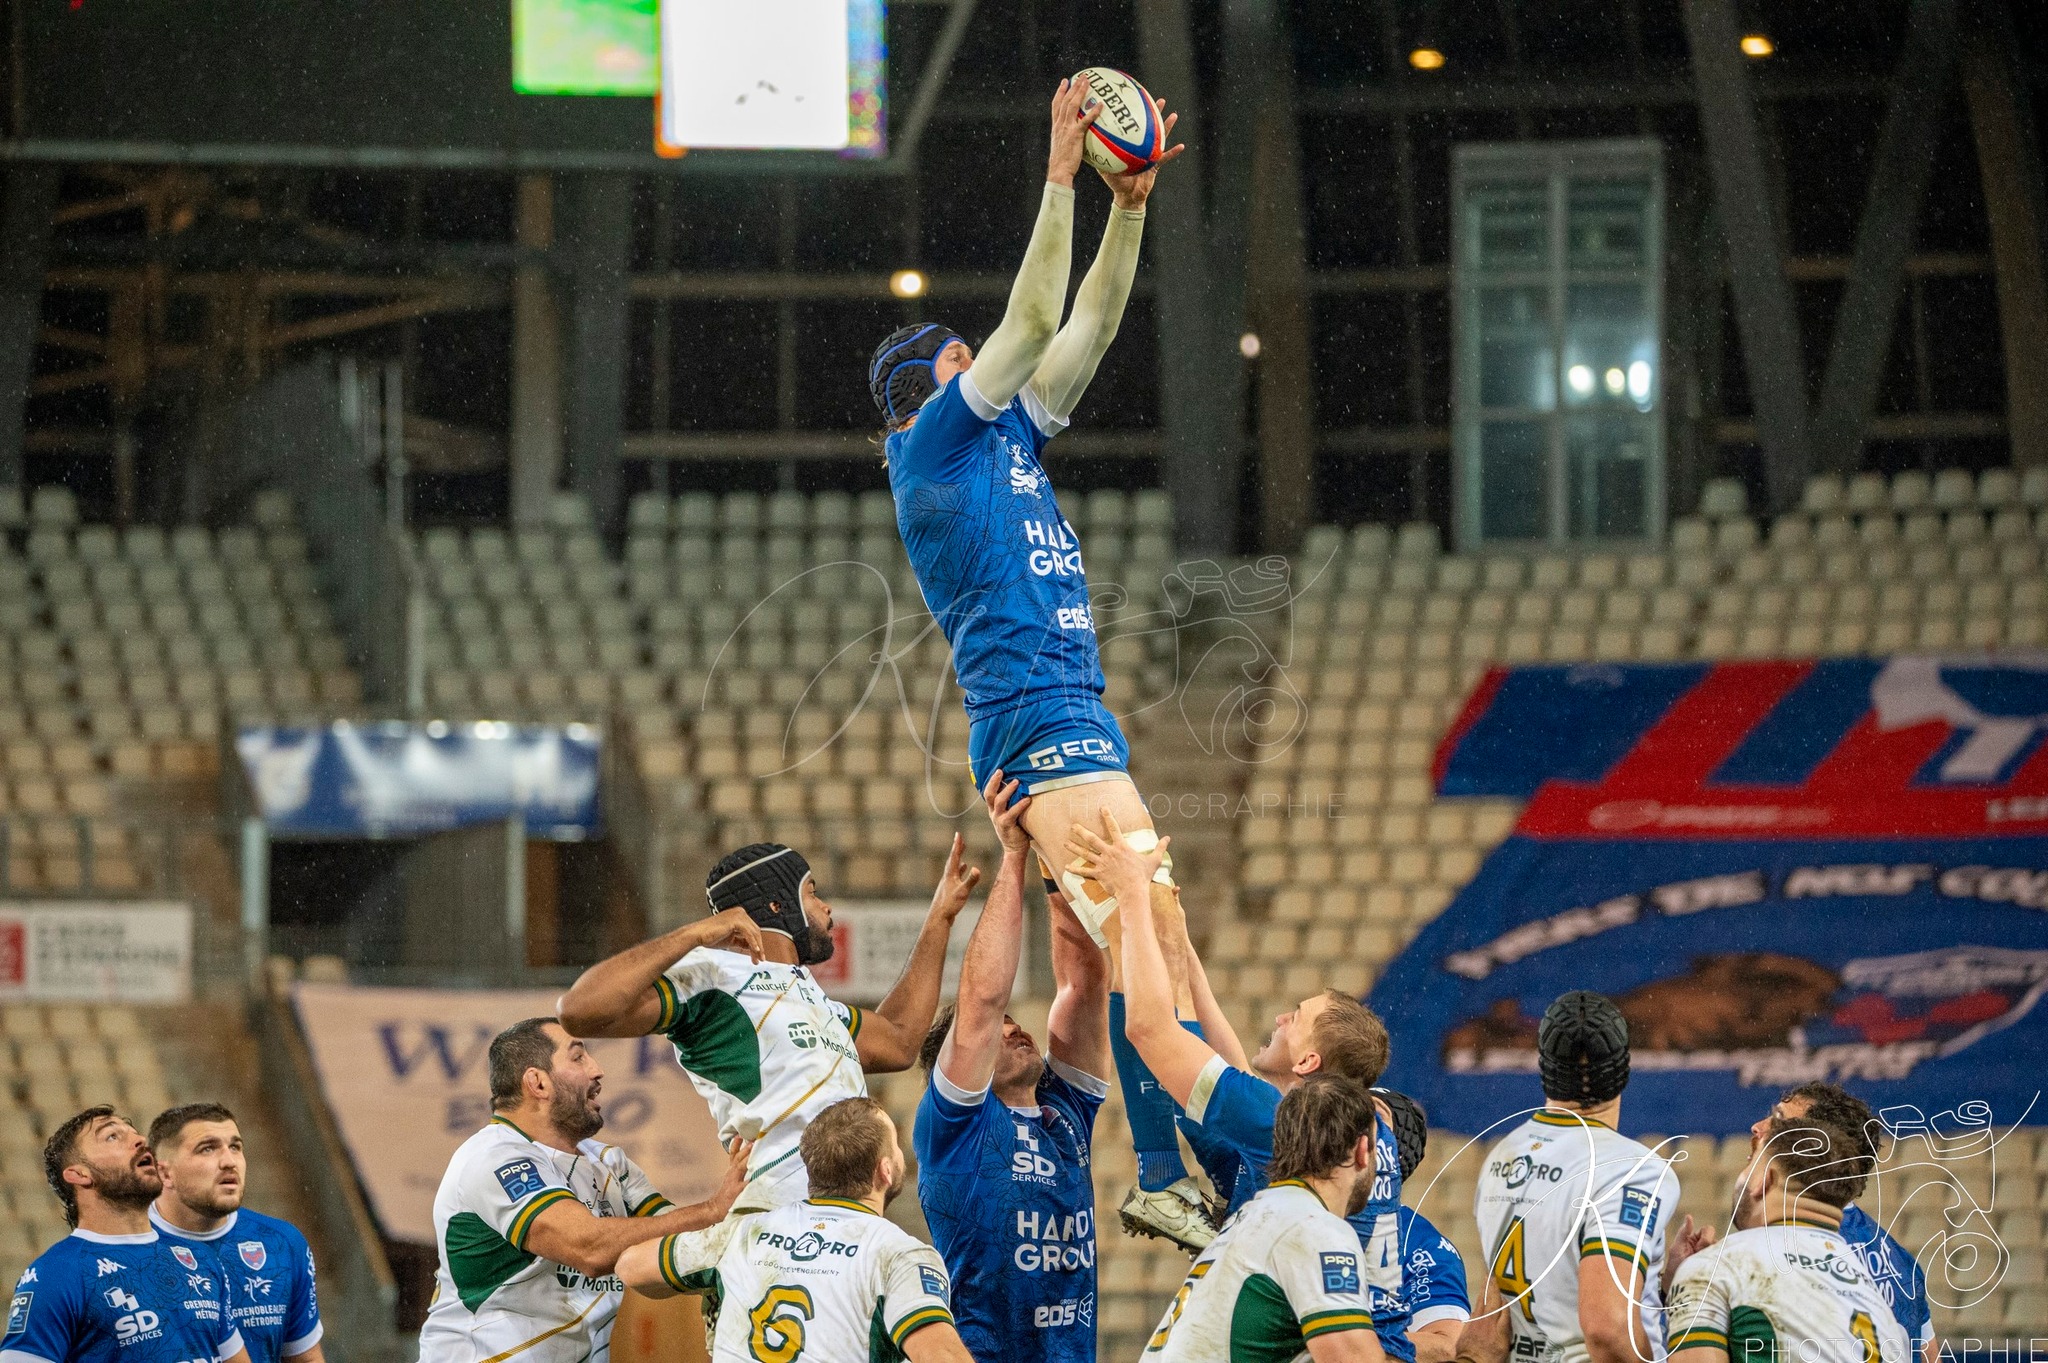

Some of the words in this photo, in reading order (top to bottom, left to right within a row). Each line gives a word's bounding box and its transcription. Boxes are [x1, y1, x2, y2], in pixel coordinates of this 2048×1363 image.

[1084, 149, 1113, 168] AICA
[1061, 738, 1117, 757] ECM
[749, 980, 789, 992] FAUCHÉ
[500, 1162, 531, 1179] PRO
[1012, 1151, 1056, 1177] SD
[509, 1177, 543, 1200] D2
[1012, 1172, 1056, 1187] SERVICES
[1324, 1256, 1355, 1266] PRO
[1494, 1215, 1539, 1325] 4
[581, 1276, 624, 1292] Monta
[1328, 1275, 1358, 1289] D2
[115, 1309, 160, 1339] SD
[243, 1315, 283, 1328] MÉTROPOLE
[748, 1284, 816, 1363] 6
[1034, 1304, 1077, 1328] eos
[120, 1329, 163, 1347] SERVICES
